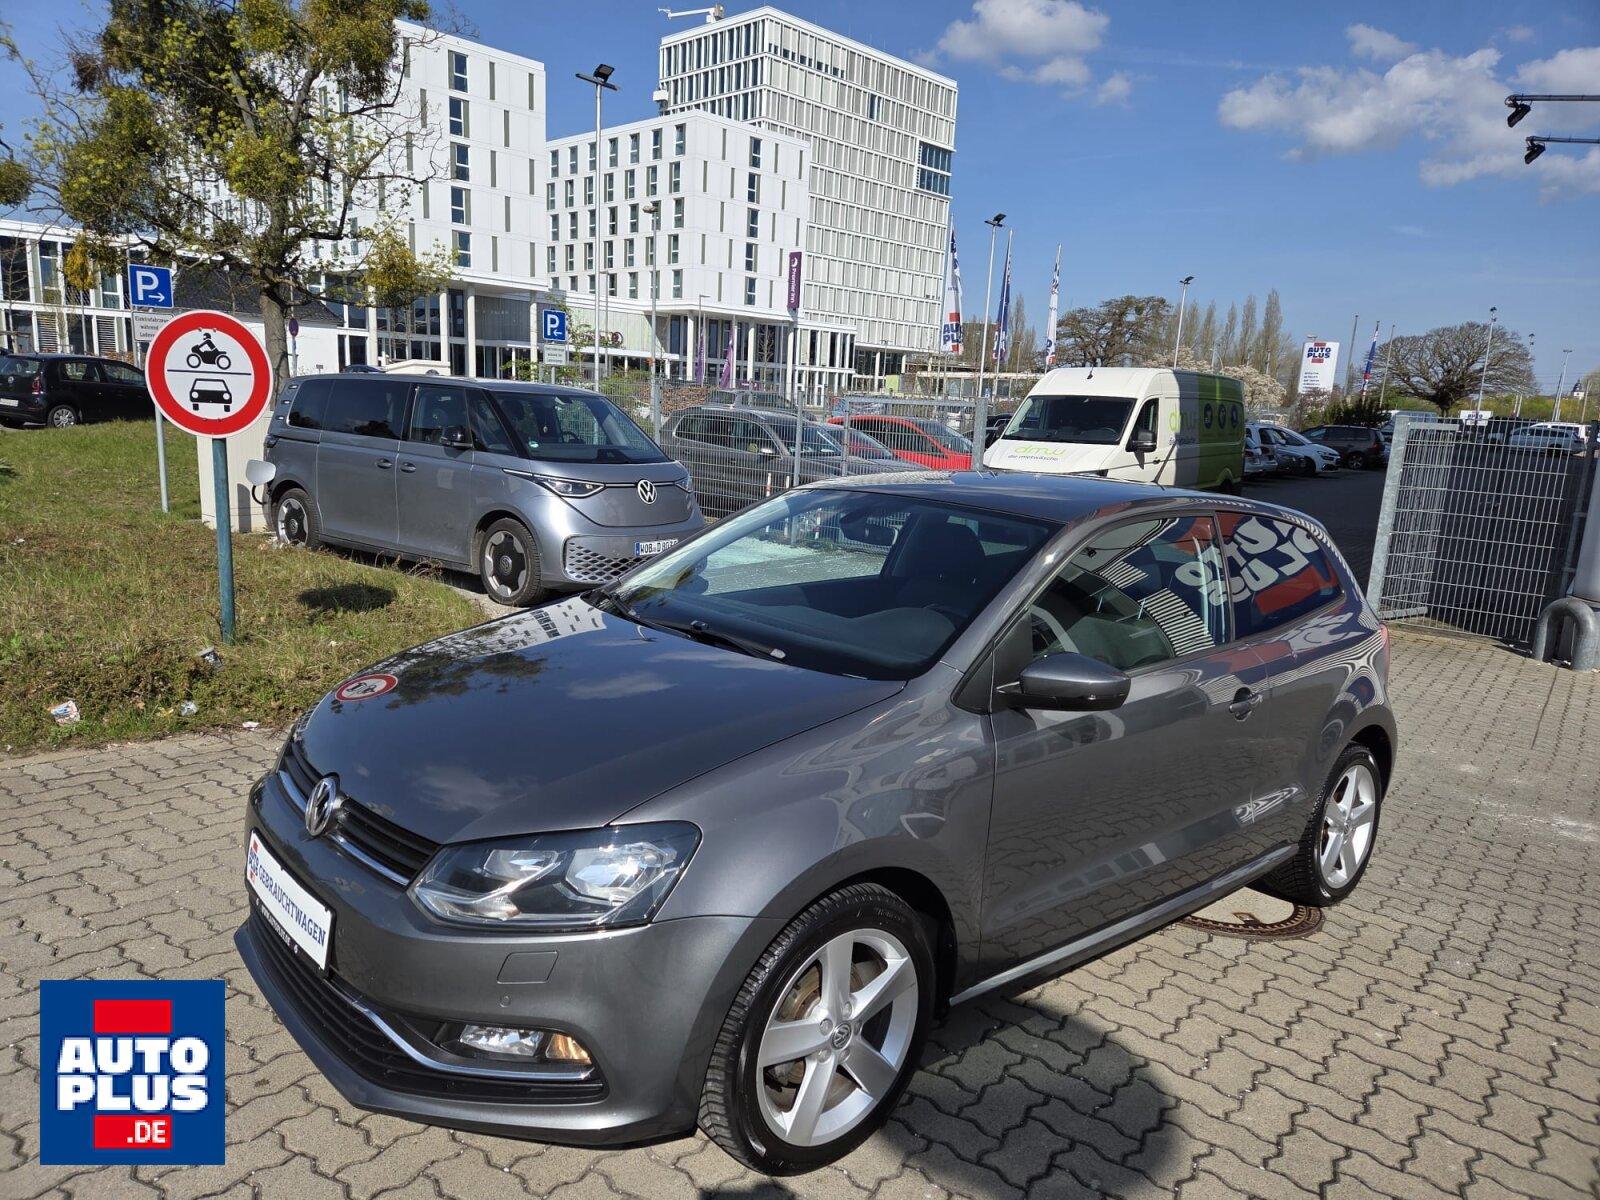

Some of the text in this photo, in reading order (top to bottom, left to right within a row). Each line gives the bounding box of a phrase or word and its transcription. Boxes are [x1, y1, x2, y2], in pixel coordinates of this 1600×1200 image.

[136, 271, 159, 300] P
[547, 314, 560, 336] P
[259, 865, 327, 947] GEBRAUCHTWAGEN
